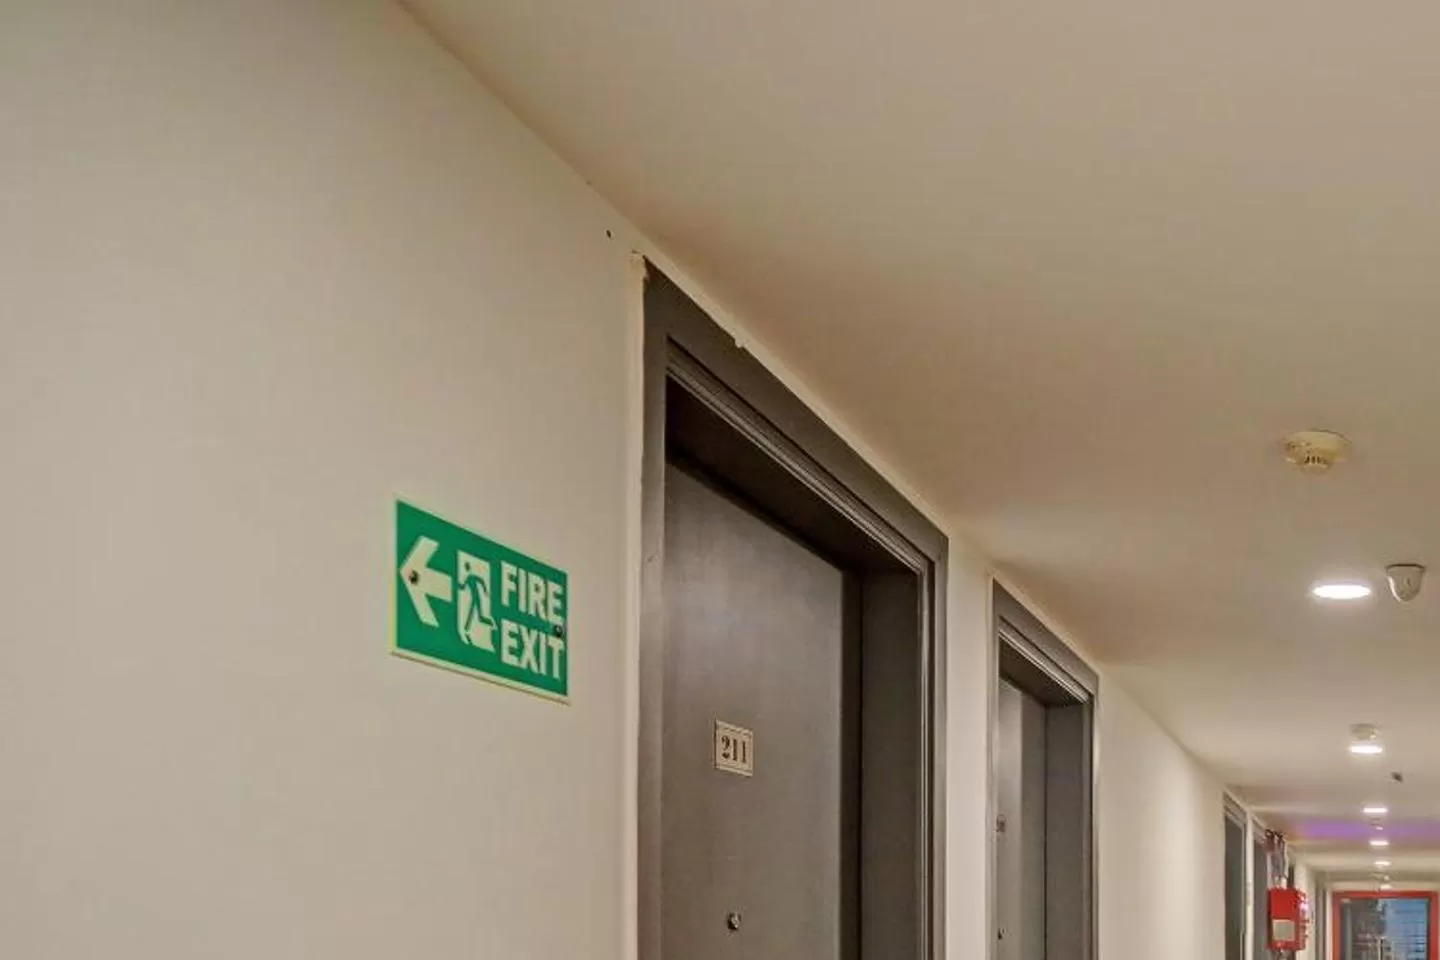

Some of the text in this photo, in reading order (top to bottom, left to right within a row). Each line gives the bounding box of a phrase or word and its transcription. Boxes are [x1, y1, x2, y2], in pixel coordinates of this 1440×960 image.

[501, 560, 563, 624] FIRE
[501, 618, 564, 679] EXIT
[721, 735, 747, 763] 211
